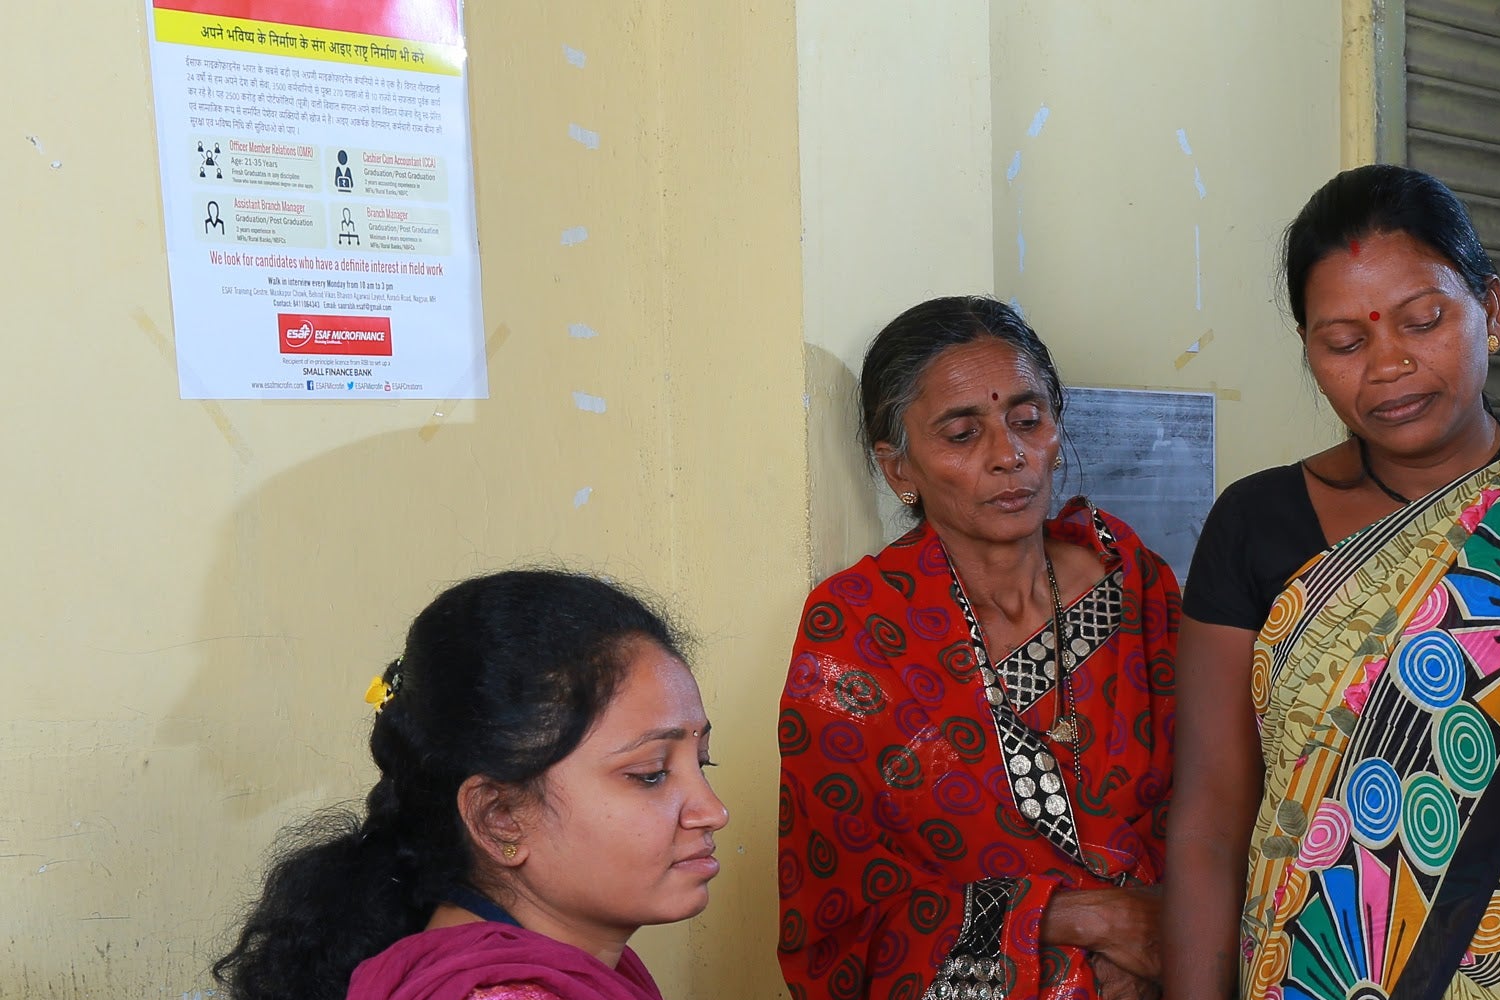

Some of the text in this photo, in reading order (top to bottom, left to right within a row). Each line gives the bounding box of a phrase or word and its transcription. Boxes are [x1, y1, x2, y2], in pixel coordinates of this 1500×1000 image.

[201, 24, 223, 40] अपने
[227, 26, 255, 44] भविष्य
[257, 28, 266, 45] के
[269, 30, 297, 49] निर्माण
[300, 33, 309, 50] के
[311, 37, 326, 53] संग
[328, 41, 352, 57] आइए
[370, 43, 397, 61] निर्माण
[399, 46, 410, 62] भी
[248, 141, 271, 154] Member
[271, 143, 296, 156] Relations
[262, 159, 278, 168] Years
[407, 171, 436, 181] Graduation
[234, 197, 306, 214] Assistant Branch Manager
[367, 207, 408, 221] Branch Manager
[282, 218, 314, 227] Graduation
[210, 250, 223, 264] We
[224, 251, 240, 265] look
[242, 252, 254, 266] for
[255, 253, 298, 269] candidates
[298, 255, 314, 269] who
[315, 256, 333, 270] have
[341, 258, 371, 273] definite
[371, 259, 399, 274] interest
[400, 261, 408, 275] in
[409, 261, 425, 275] field
[426, 262, 444, 277] work
[268, 277, 281, 285] Walk
[282, 277, 288, 286] in
[288, 278, 311, 287] interview
[312, 280, 326, 288] every
[327, 280, 346, 289] Monday
[347, 280, 359, 289] from
[386, 283, 394, 291] pm
[314, 329, 331, 339] ESAF
[331, 330, 386, 341] MICROFINANCE
[303, 367, 373, 378] SMALL FINANCE BANK
